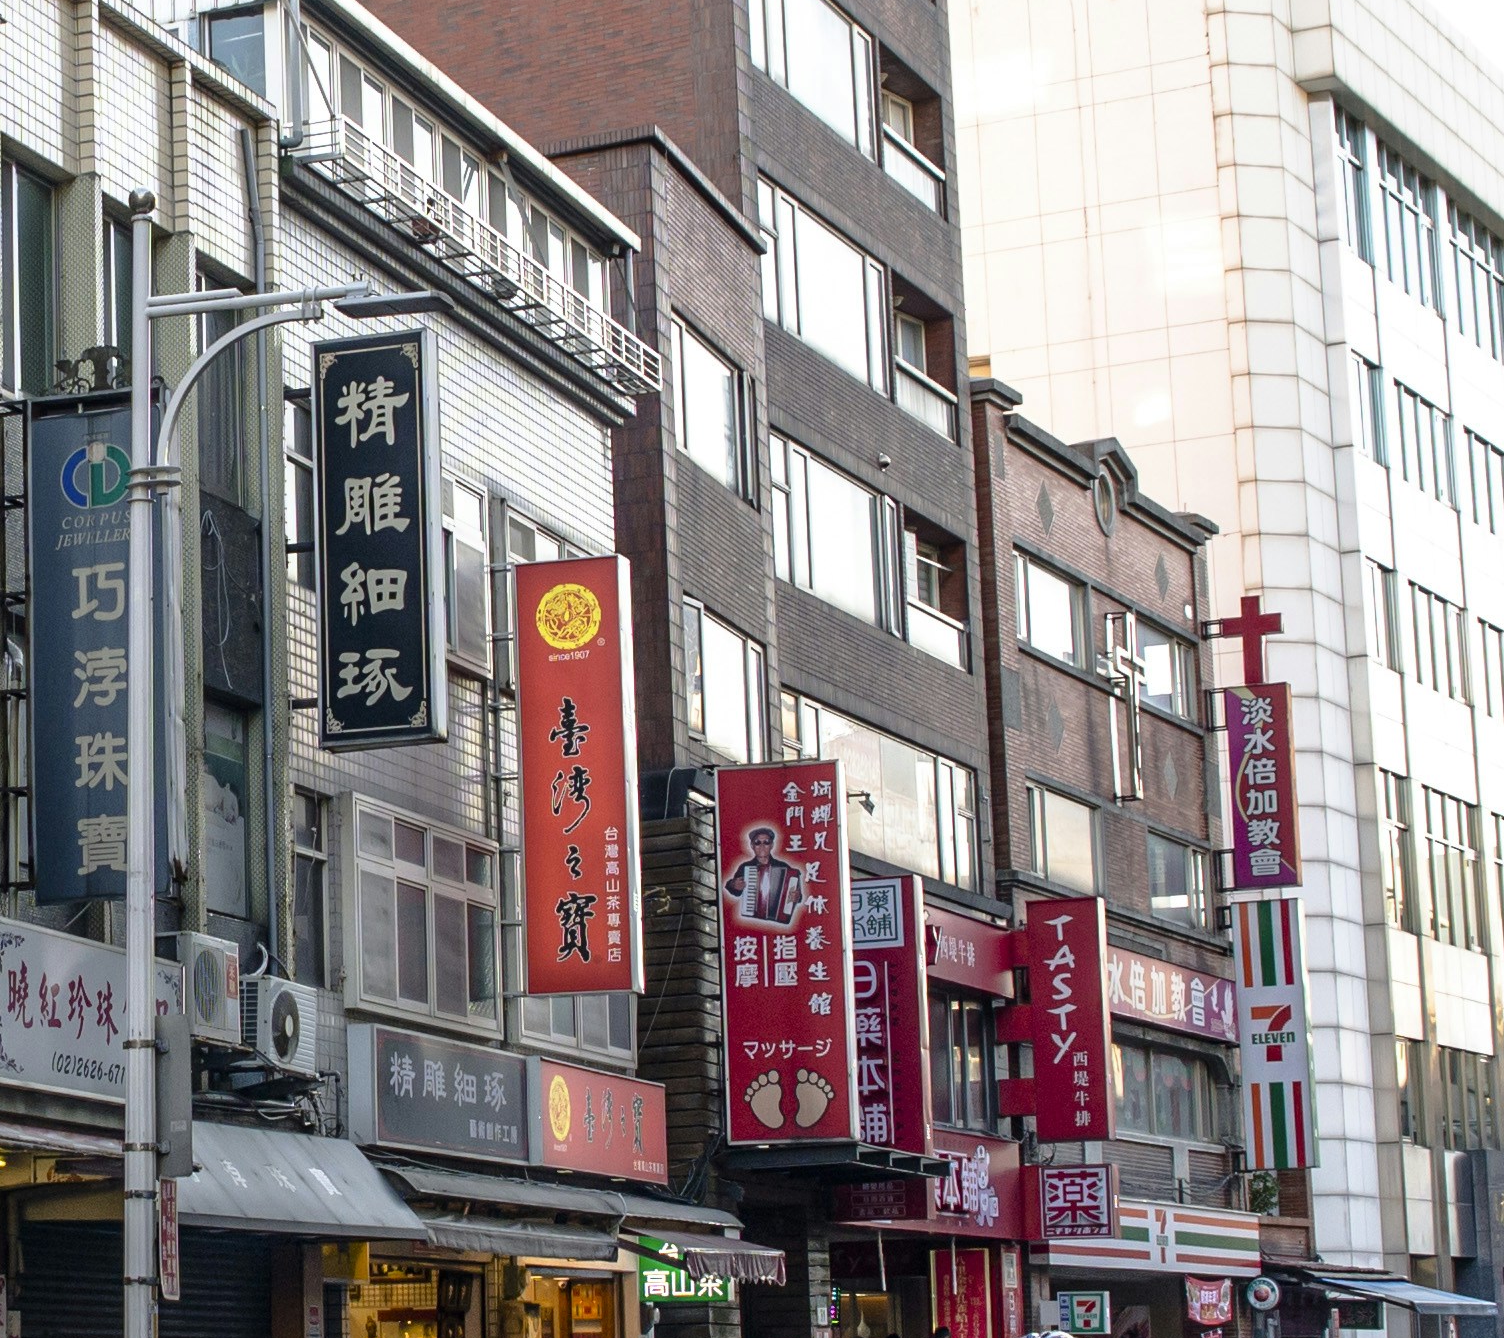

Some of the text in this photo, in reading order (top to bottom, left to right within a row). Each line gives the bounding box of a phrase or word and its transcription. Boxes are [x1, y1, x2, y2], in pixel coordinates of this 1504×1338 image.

[56, 529, 131, 550] JEWELLER
[62, 510, 131, 530] CORPUS
[335, 375, 413, 707] 精雕細琢
[1240, 696, 1283, 877] 淡水倍加教會
[549, 698, 596, 963] 臺灣之寶
[783, 782, 806, 852] 金門王
[603, 826, 621, 963] 台灣高山茶專賣店
[734, 936, 758, 987] 按摩
[774, 935, 798, 987] 指壓
[1044, 915, 1078, 1065] TASTY
[7, 959, 169, 1047] 曉紅珍珠
[1252, 1003, 1292, 1061] 7
[51, 1050, 127, 1085] (02)2626-671
[743, 1039, 833, 1060] マッサージ
[390, 1052, 508, 1112] 精雕細琢
[1072, 1051, 1091, 1128] 西堤牛排
[935, 1153, 978, 1212] 本舖
